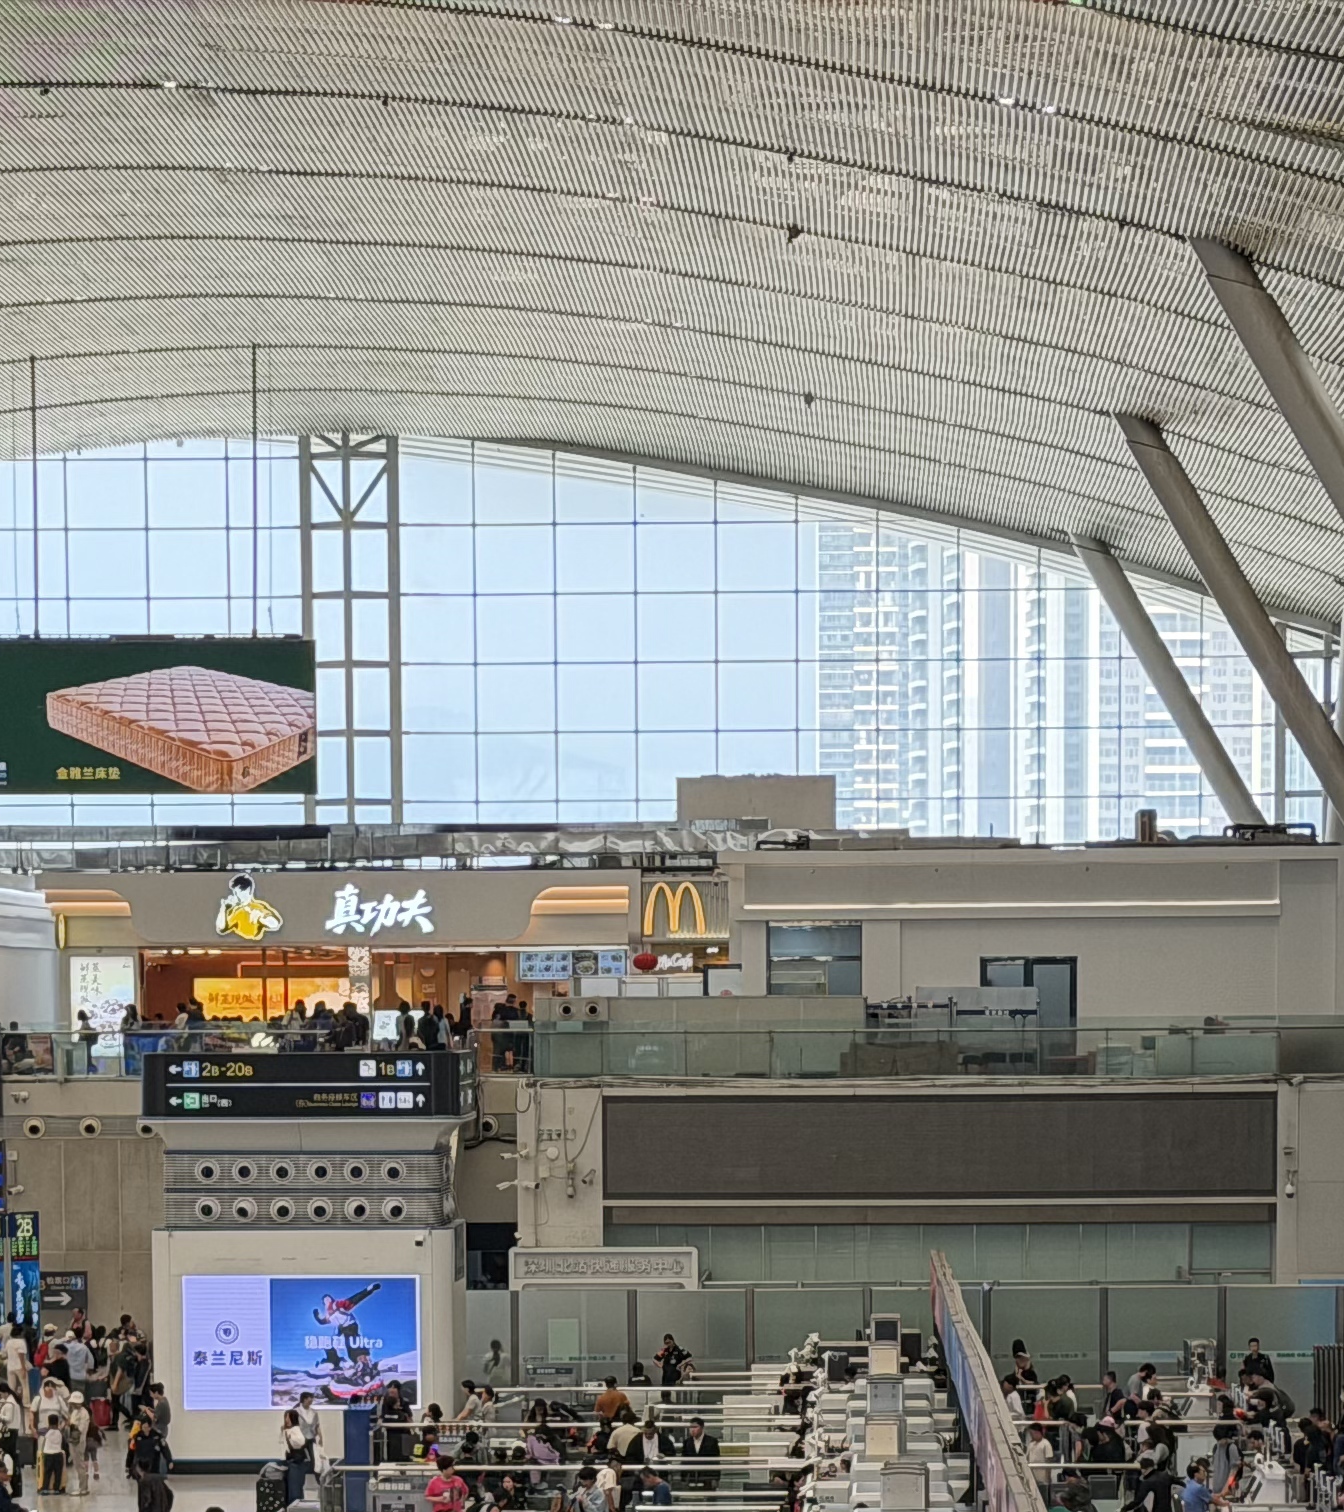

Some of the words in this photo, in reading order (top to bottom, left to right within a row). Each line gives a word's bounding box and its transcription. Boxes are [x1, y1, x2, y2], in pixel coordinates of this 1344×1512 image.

[56, 766, 120, 779] 金雅兰床垫
[324, 883, 435, 936] 真功夫
[202, 1062, 253, 1077] 2B-20B
[379, 1062, 395, 1076] 1B
[16, 1218, 33, 1236] 2B
[349, 1335, 383, 1349] Ultra
[193, 1350, 263, 1366] 泰兰尼斯
